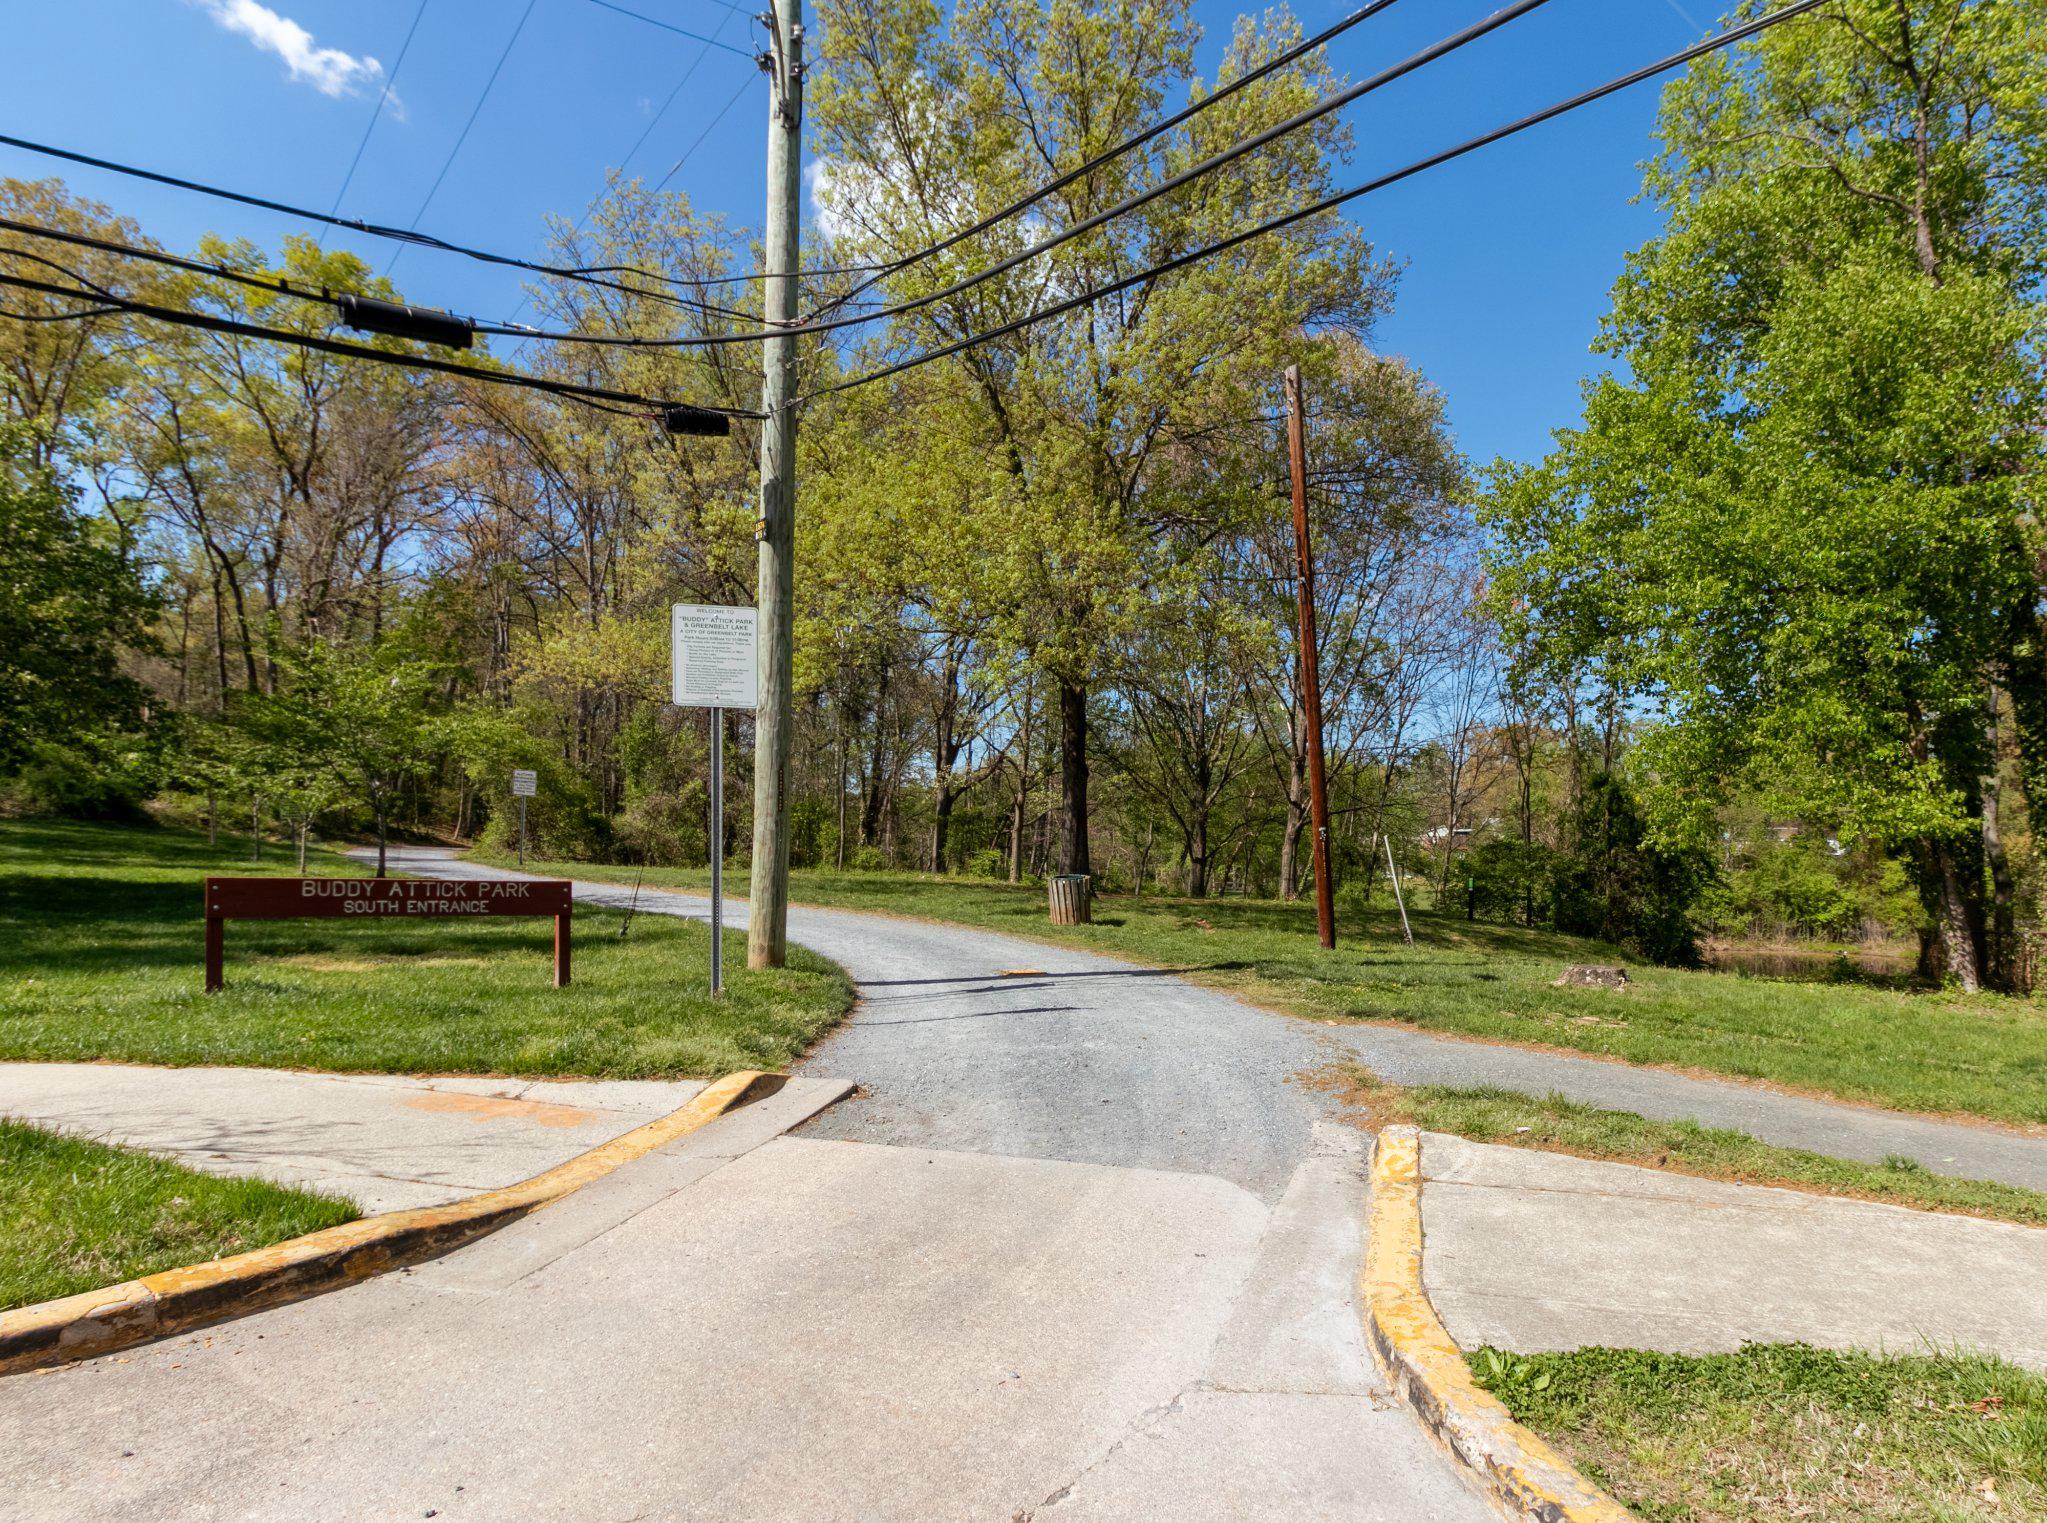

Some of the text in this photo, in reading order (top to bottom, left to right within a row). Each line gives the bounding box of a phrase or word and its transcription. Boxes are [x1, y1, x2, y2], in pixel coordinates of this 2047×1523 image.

[301, 880, 530, 898] BUDDY ATTICK PARK
[343, 900, 490, 913] SOUTH ENTRANCE
